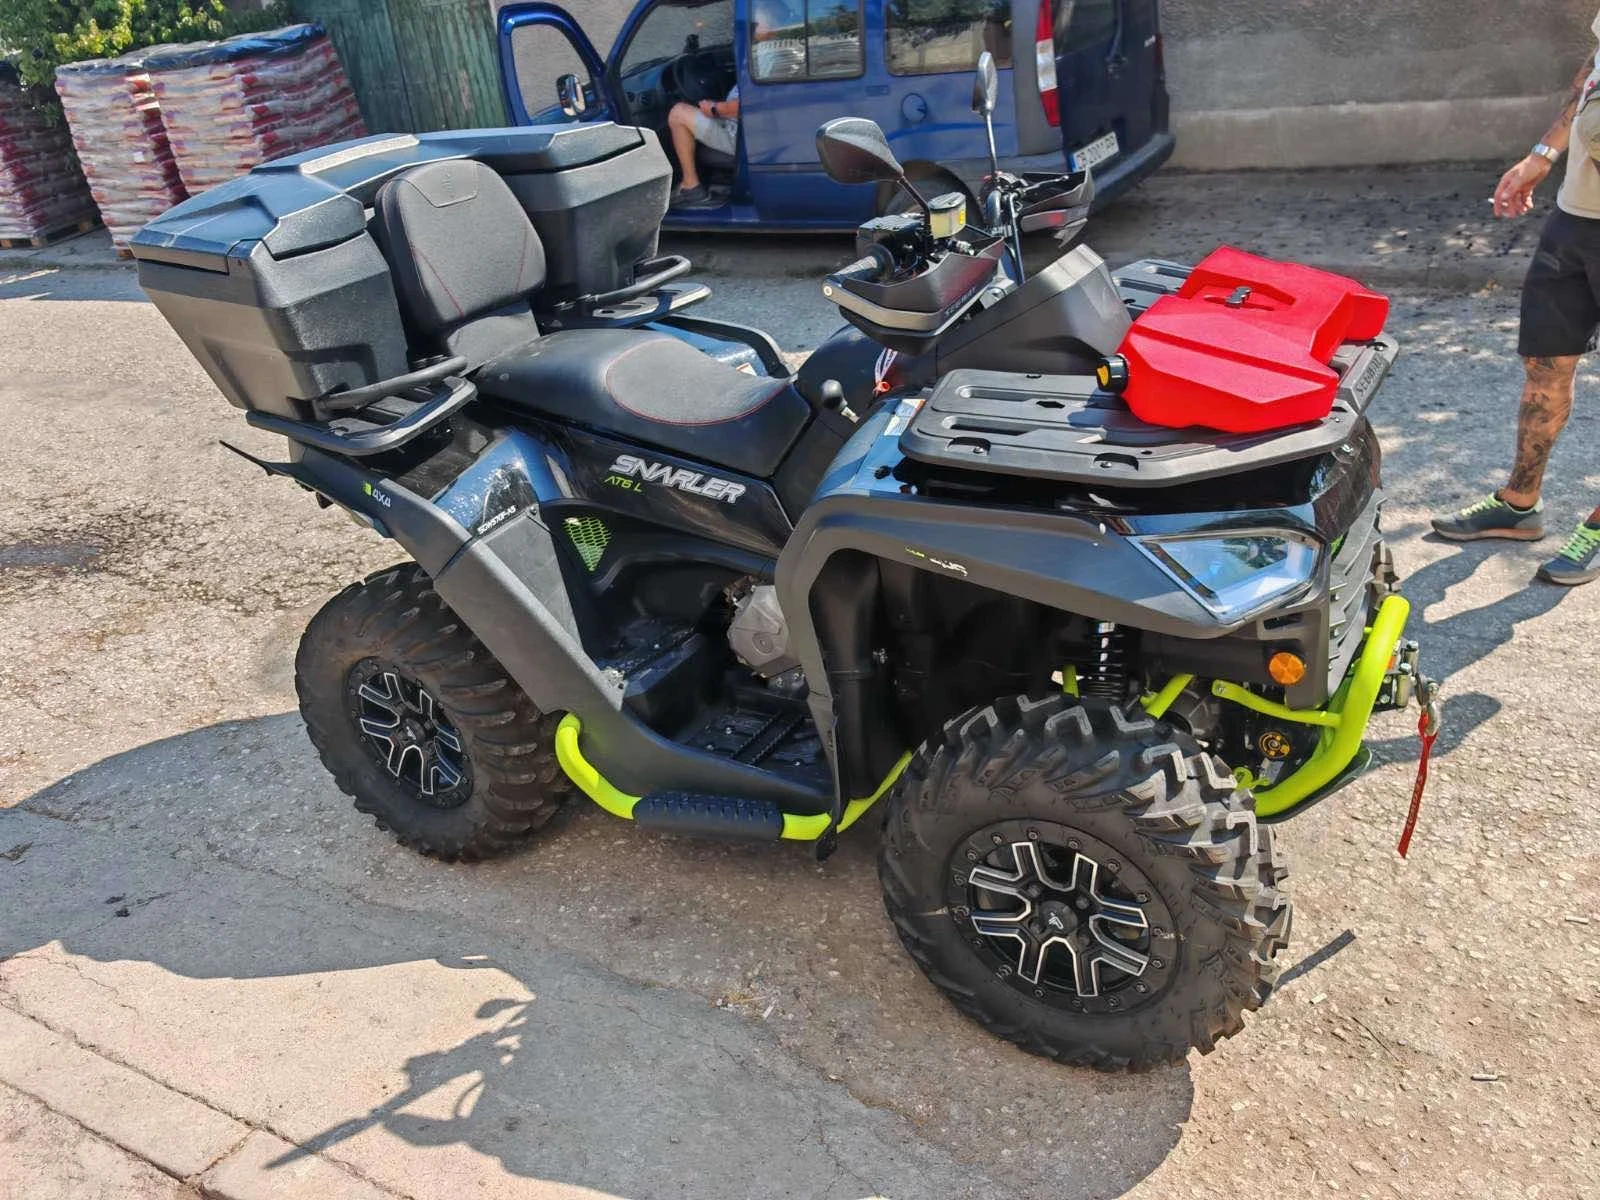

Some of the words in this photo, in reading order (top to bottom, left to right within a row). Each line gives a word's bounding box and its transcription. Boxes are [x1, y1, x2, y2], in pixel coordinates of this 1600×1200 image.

[604, 475, 632, 489] AT6
[633, 482, 643, 493] L
[609, 454, 746, 503] SNARLER
